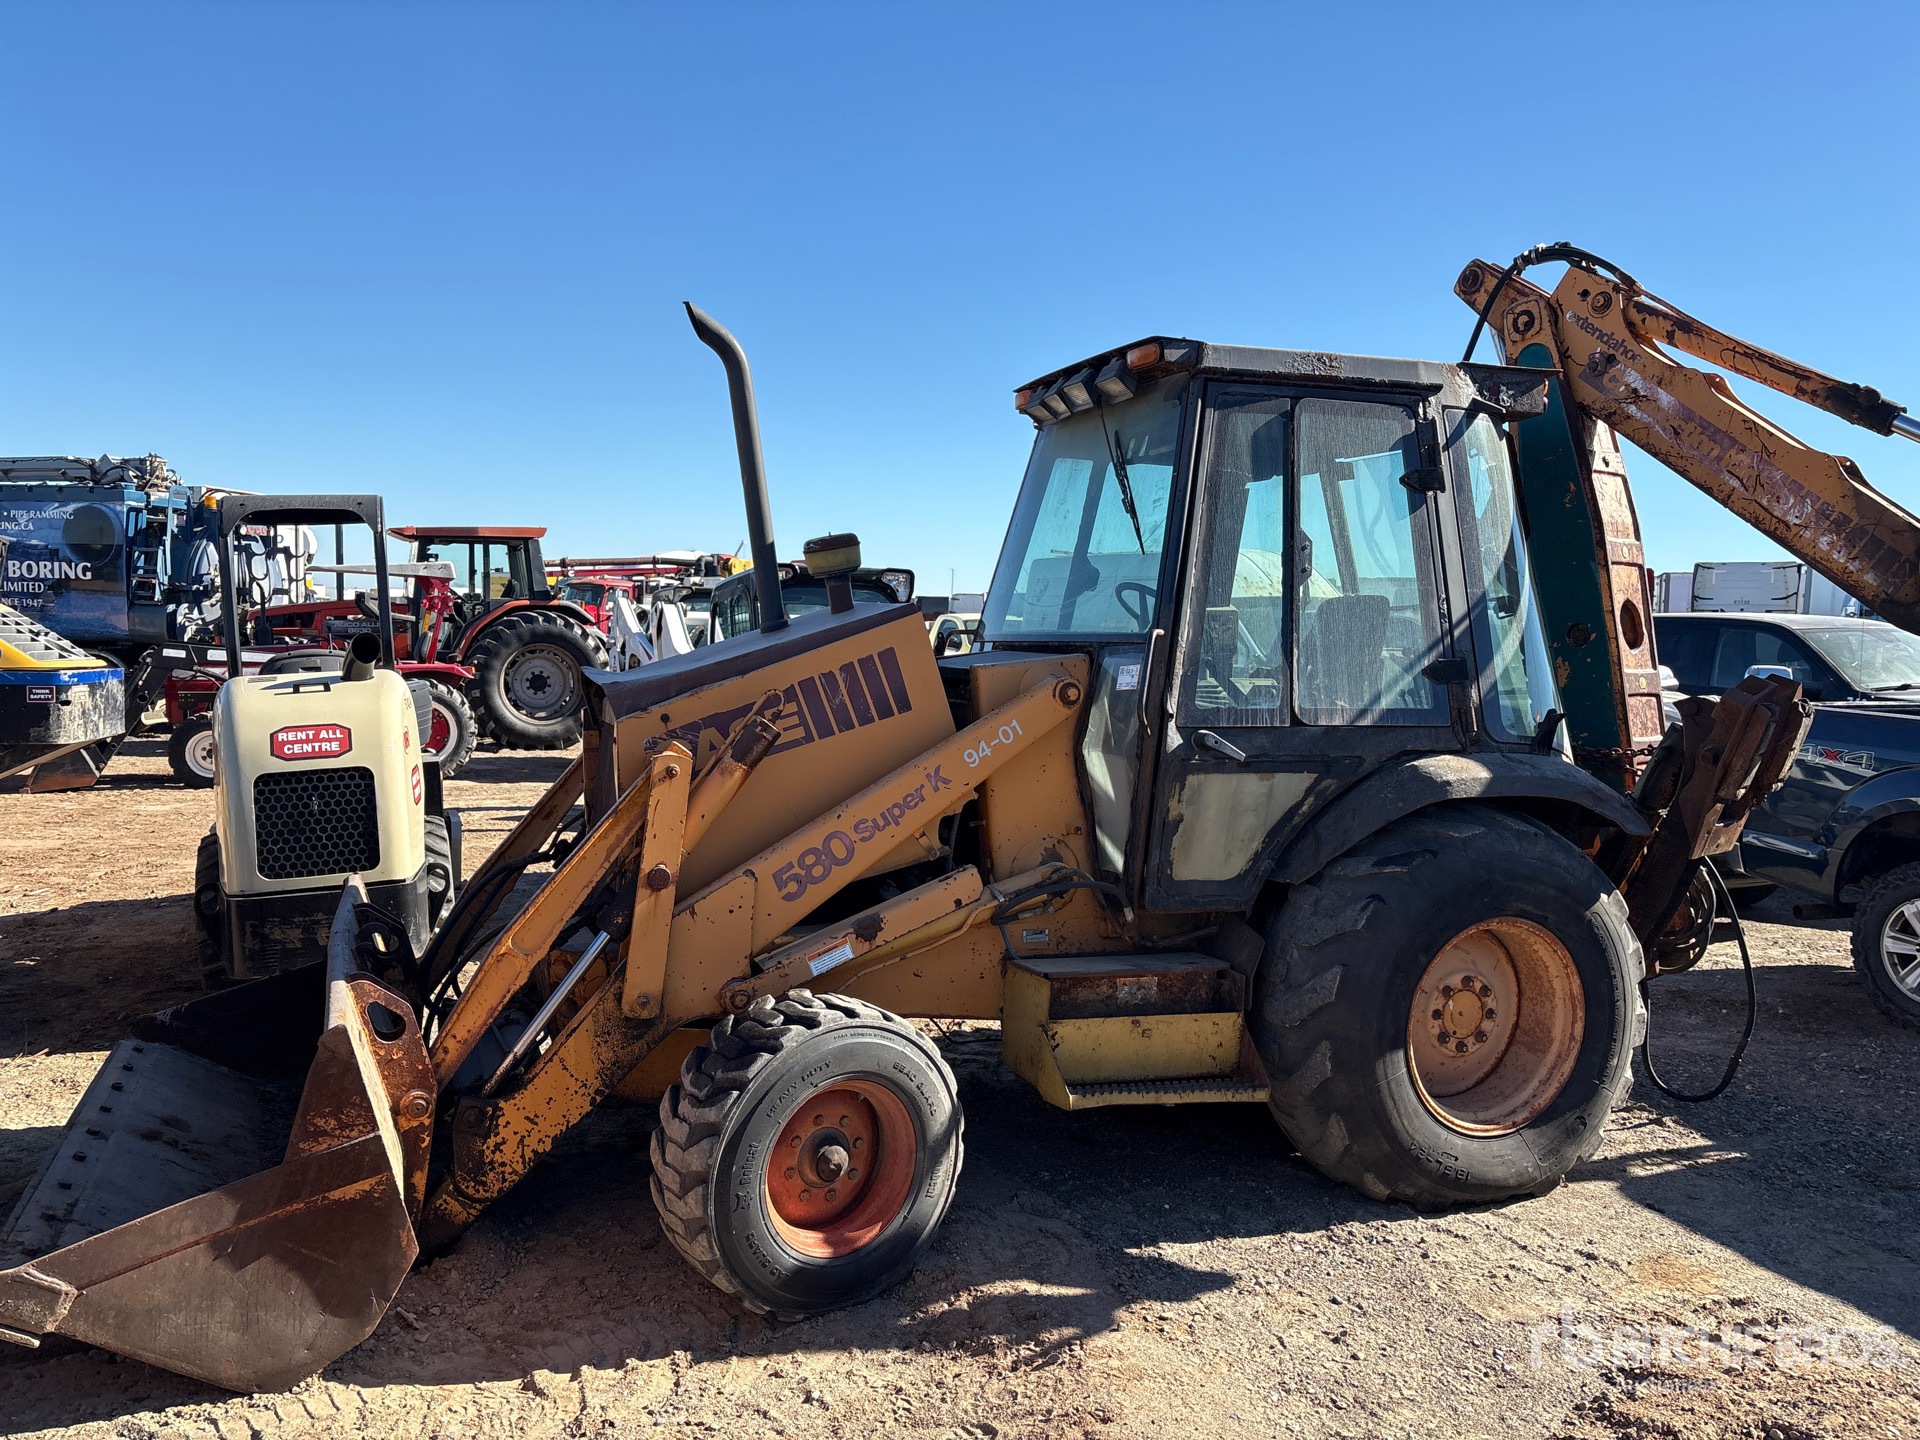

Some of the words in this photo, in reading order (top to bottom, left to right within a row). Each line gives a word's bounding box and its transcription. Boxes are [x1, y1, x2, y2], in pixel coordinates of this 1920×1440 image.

[10, 509, 29, 519] PIPE
[29, 510, 74, 520] RAMMING
[0, 521, 34, 531] ING.CA
[7, 560, 92, 580] BORING
[22, 598, 43, 608] 1947
[277, 730, 316, 742] RENT
[319, 729, 344, 739] ALL
[963, 719, 1024, 768] 94-01
[284, 741, 340, 755] CENTRE
[771, 830, 856, 902] 580
[853, 784, 925, 843] Super
[925, 764, 953, 793] K
[766, 1081, 798, 1119] HEAVY
[801, 1060, 834, 1084] DUTY
[892, 1060, 917, 1083] BEAD
[917, 1082, 938, 1118] GUARD
